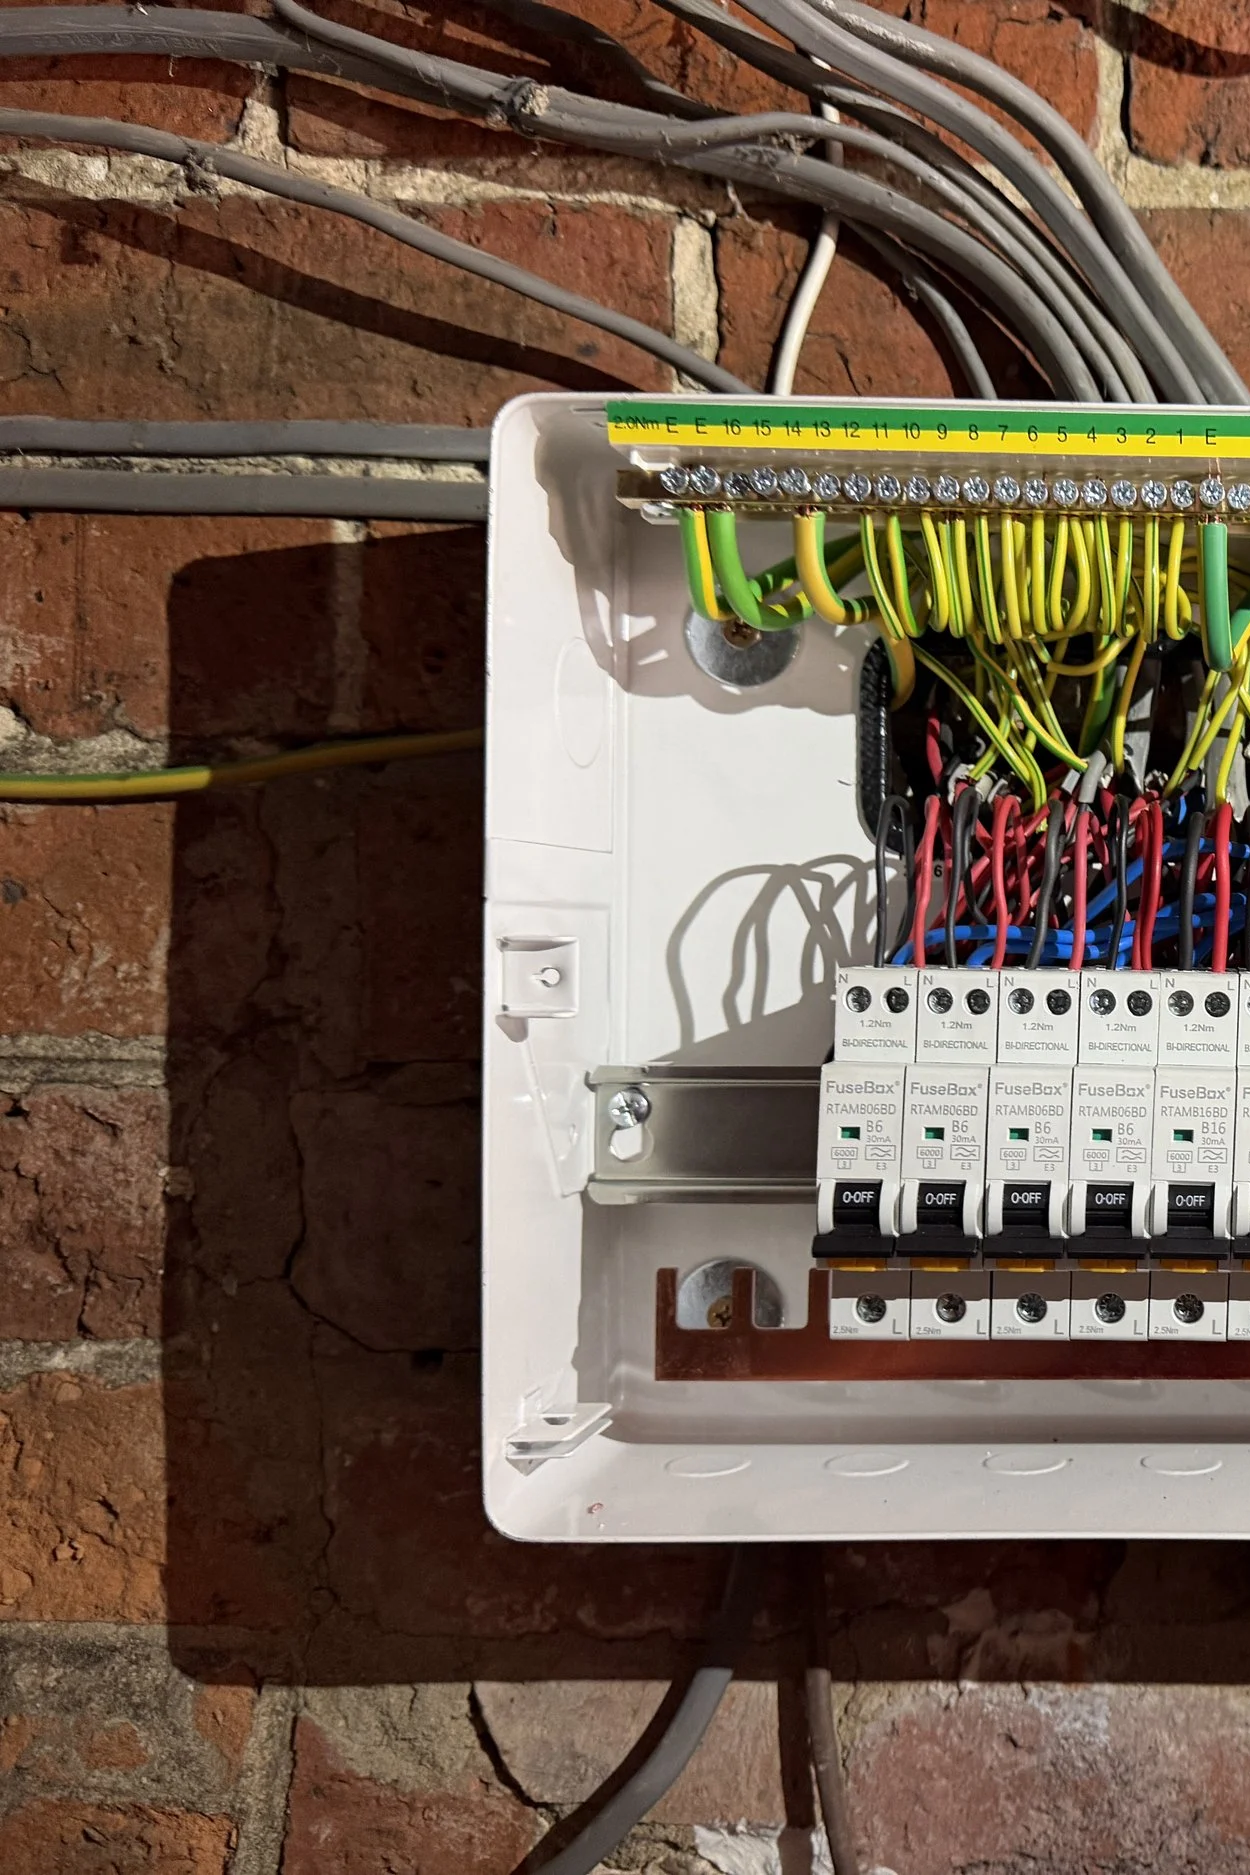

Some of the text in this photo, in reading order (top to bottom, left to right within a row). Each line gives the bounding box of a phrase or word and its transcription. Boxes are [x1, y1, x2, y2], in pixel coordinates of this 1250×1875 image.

[615, 416, 1217, 446] 2.0Nm E E 16 15 14 13 12 11 10 9 8 7 6 5 4 3 2 1 E
[942, 1021, 972, 1029] 1.2Nm
[1184, 1024, 1214, 1032] 1.2Nm
[842, 1039, 908, 1048] BI-DIRECTIONAL
[924, 1040, 988, 1049] BI-DIRECTIONAL
[1006, 1041, 1069, 1051] BI-DIRECTIONAL
[1089, 1042, 1152, 1052] BI-DIRECTIONAL
[1167, 1043, 1229, 1052] BI-DIRECTIONAL
[1161, 1106, 1228, 1118] RTAMB16BD
[867, 1120, 882, 1132] B6
[952, 1120, 968, 1133] B6
[1035, 1122, 1051, 1134] B6
[1118, 1123, 1133, 1135] B6
[1202, 1122, 1225, 1134] B16
[867, 1135, 891, 1143] 30mA
[951, 1135, 976, 1145] 30mA
[1036, 1136, 1059, 1144] 30mA
[1118, 1137, 1141, 1145] 30mA
[1202, 1137, 1225, 1145] 30mA
